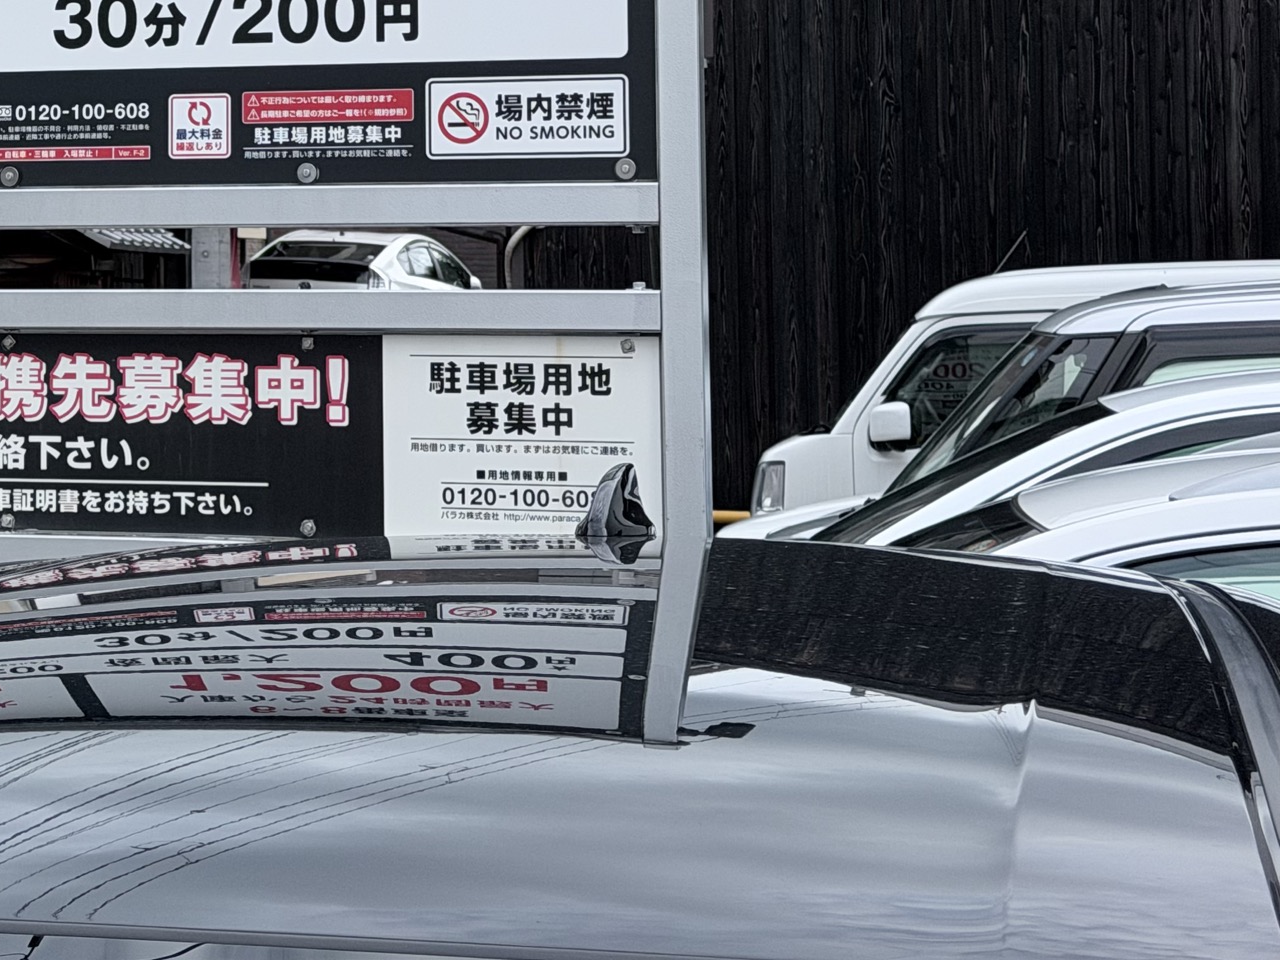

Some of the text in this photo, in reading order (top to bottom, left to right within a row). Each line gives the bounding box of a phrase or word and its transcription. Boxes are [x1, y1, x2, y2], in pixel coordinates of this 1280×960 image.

[15, 102, 150, 121] 0120-100-608
[495, 92, 614, 122] 場内禁煙
[176, 128, 223, 140] 最大料金
[254, 125, 402, 145] 駐車場用地募集中
[496, 125, 615, 140] NO SMOKING
[429, 361, 612, 396] 駐車場用地
[466, 401, 573, 436] 募集中
[441, 511, 500, 521] パラカ株式会社
